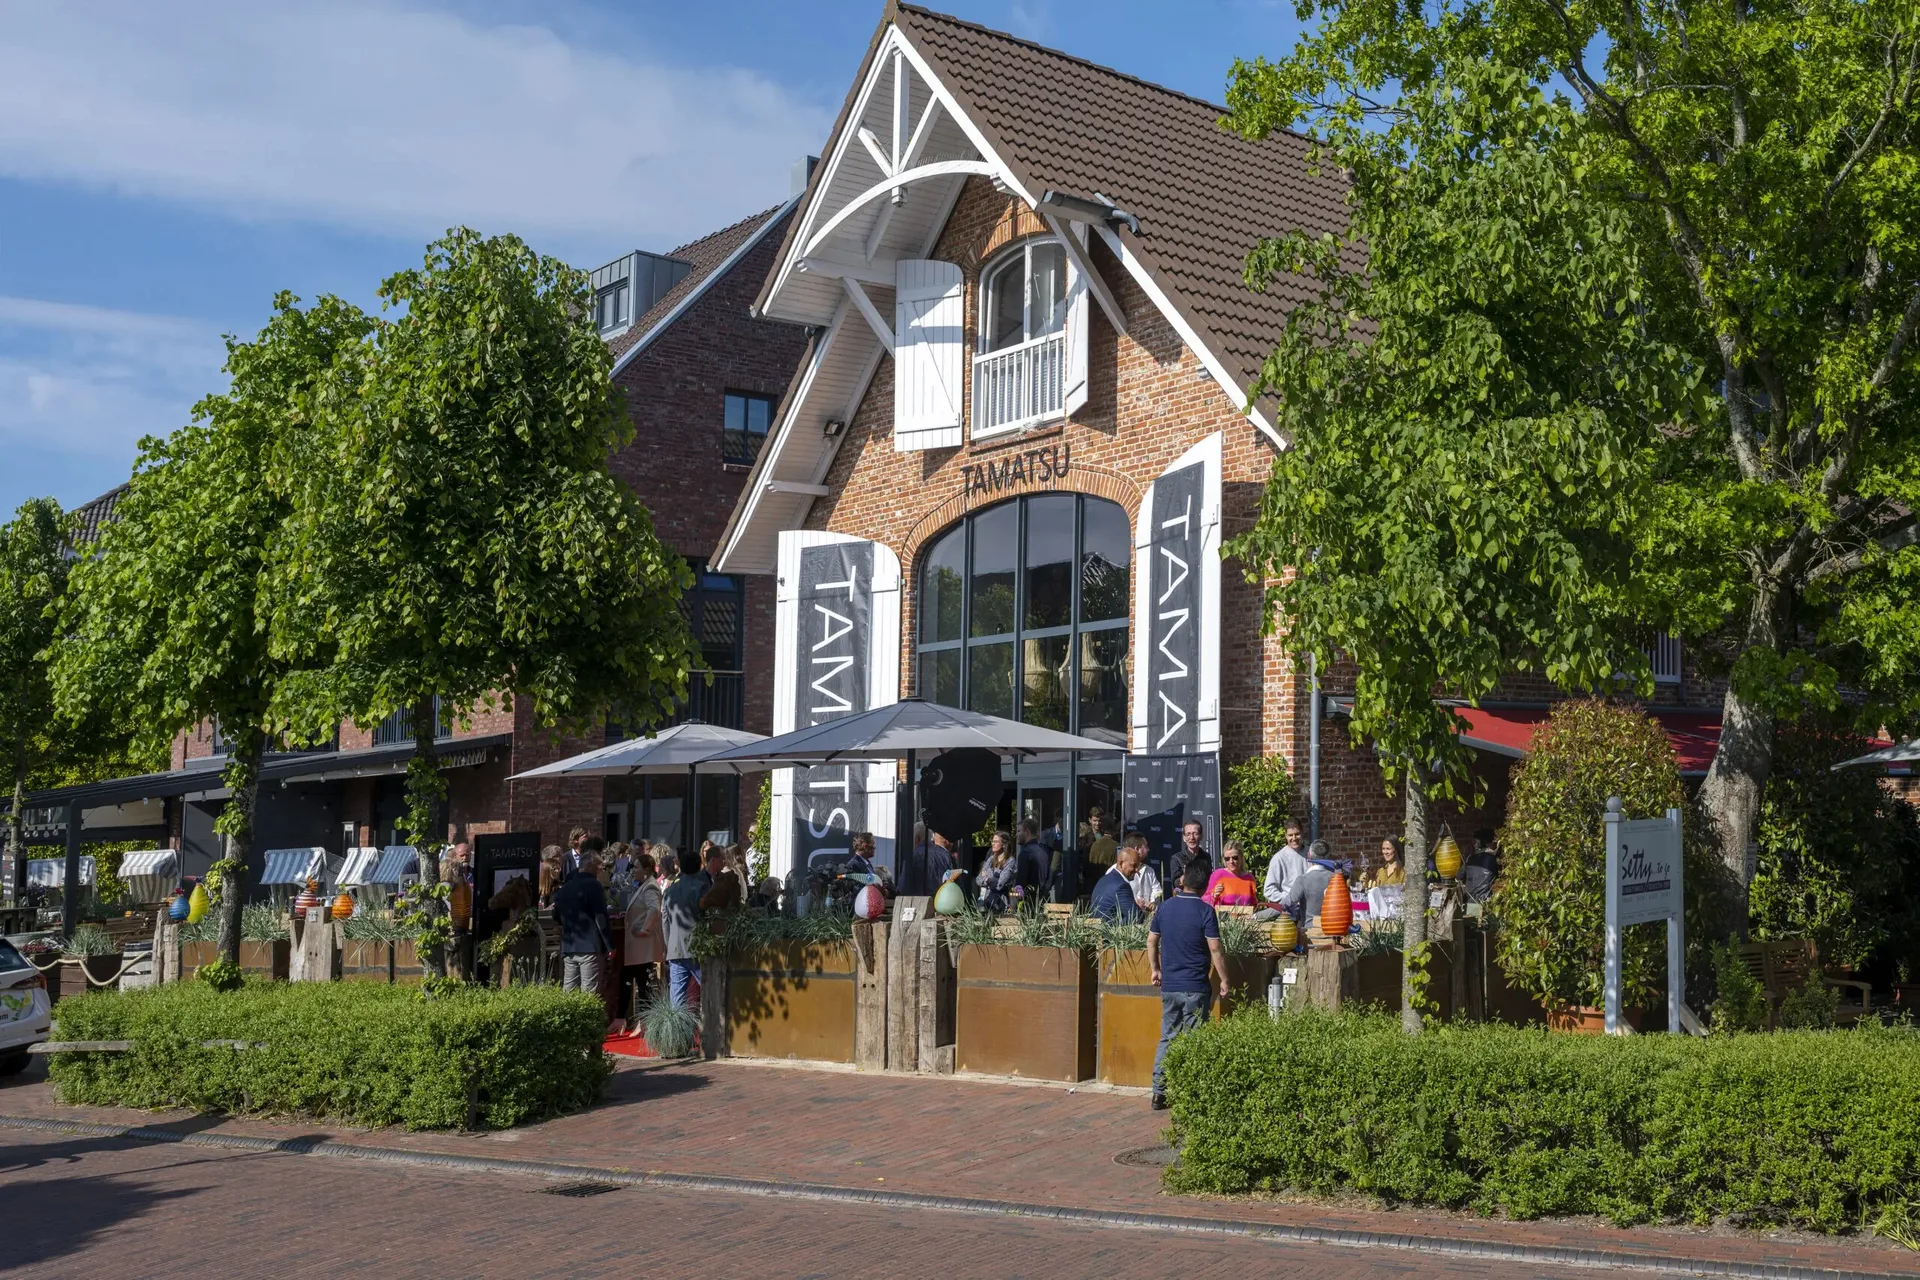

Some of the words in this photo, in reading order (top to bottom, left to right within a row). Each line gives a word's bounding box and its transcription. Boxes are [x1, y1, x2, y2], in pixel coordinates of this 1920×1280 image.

[960, 443, 1071, 498] TAMATSU
[1156, 495, 1192, 754] TAMA
[490, 847, 533, 859] TAMATSU
